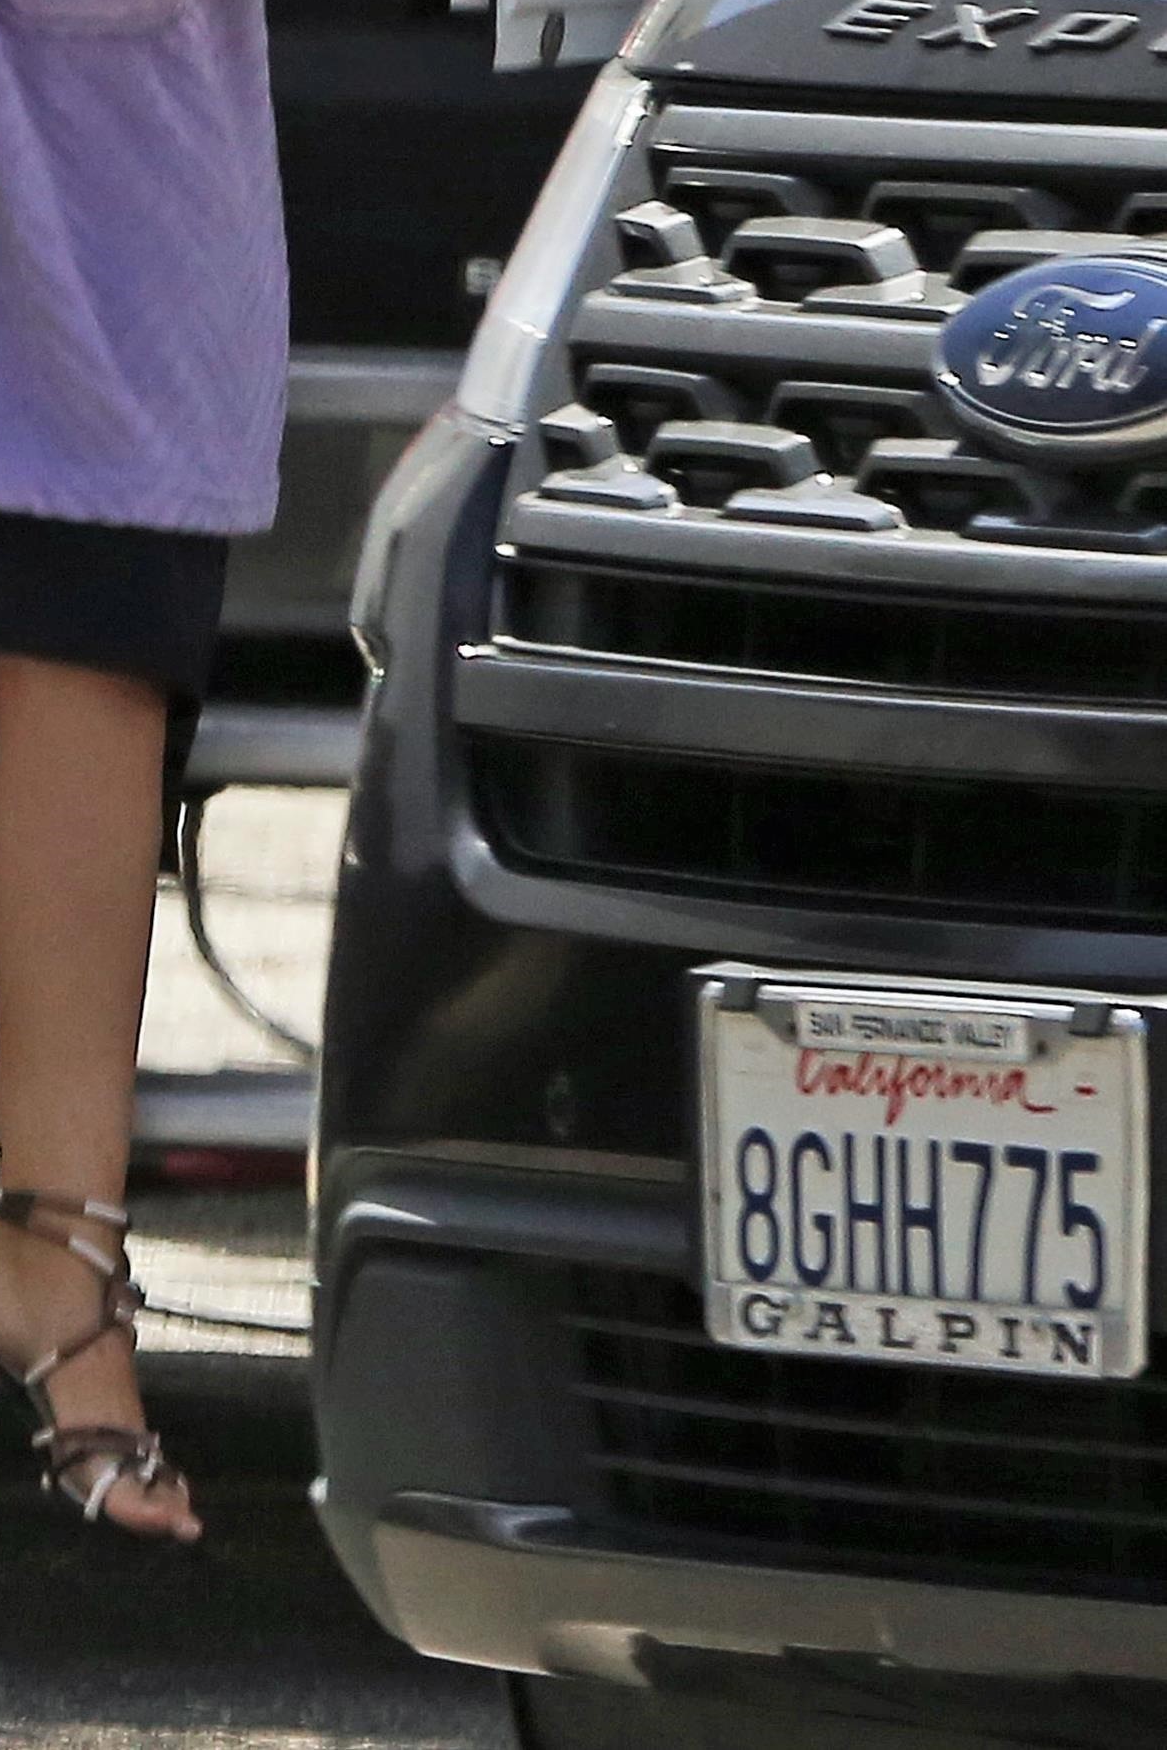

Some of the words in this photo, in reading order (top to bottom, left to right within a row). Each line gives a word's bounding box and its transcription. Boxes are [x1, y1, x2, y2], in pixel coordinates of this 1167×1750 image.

[976, 283, 1167, 394] Ford
[795, 1047, 1058, 1126] California
[738, 1125, 1106, 1311] 8GHH775
[740, 1293, 1094, 1364] GALPIN
